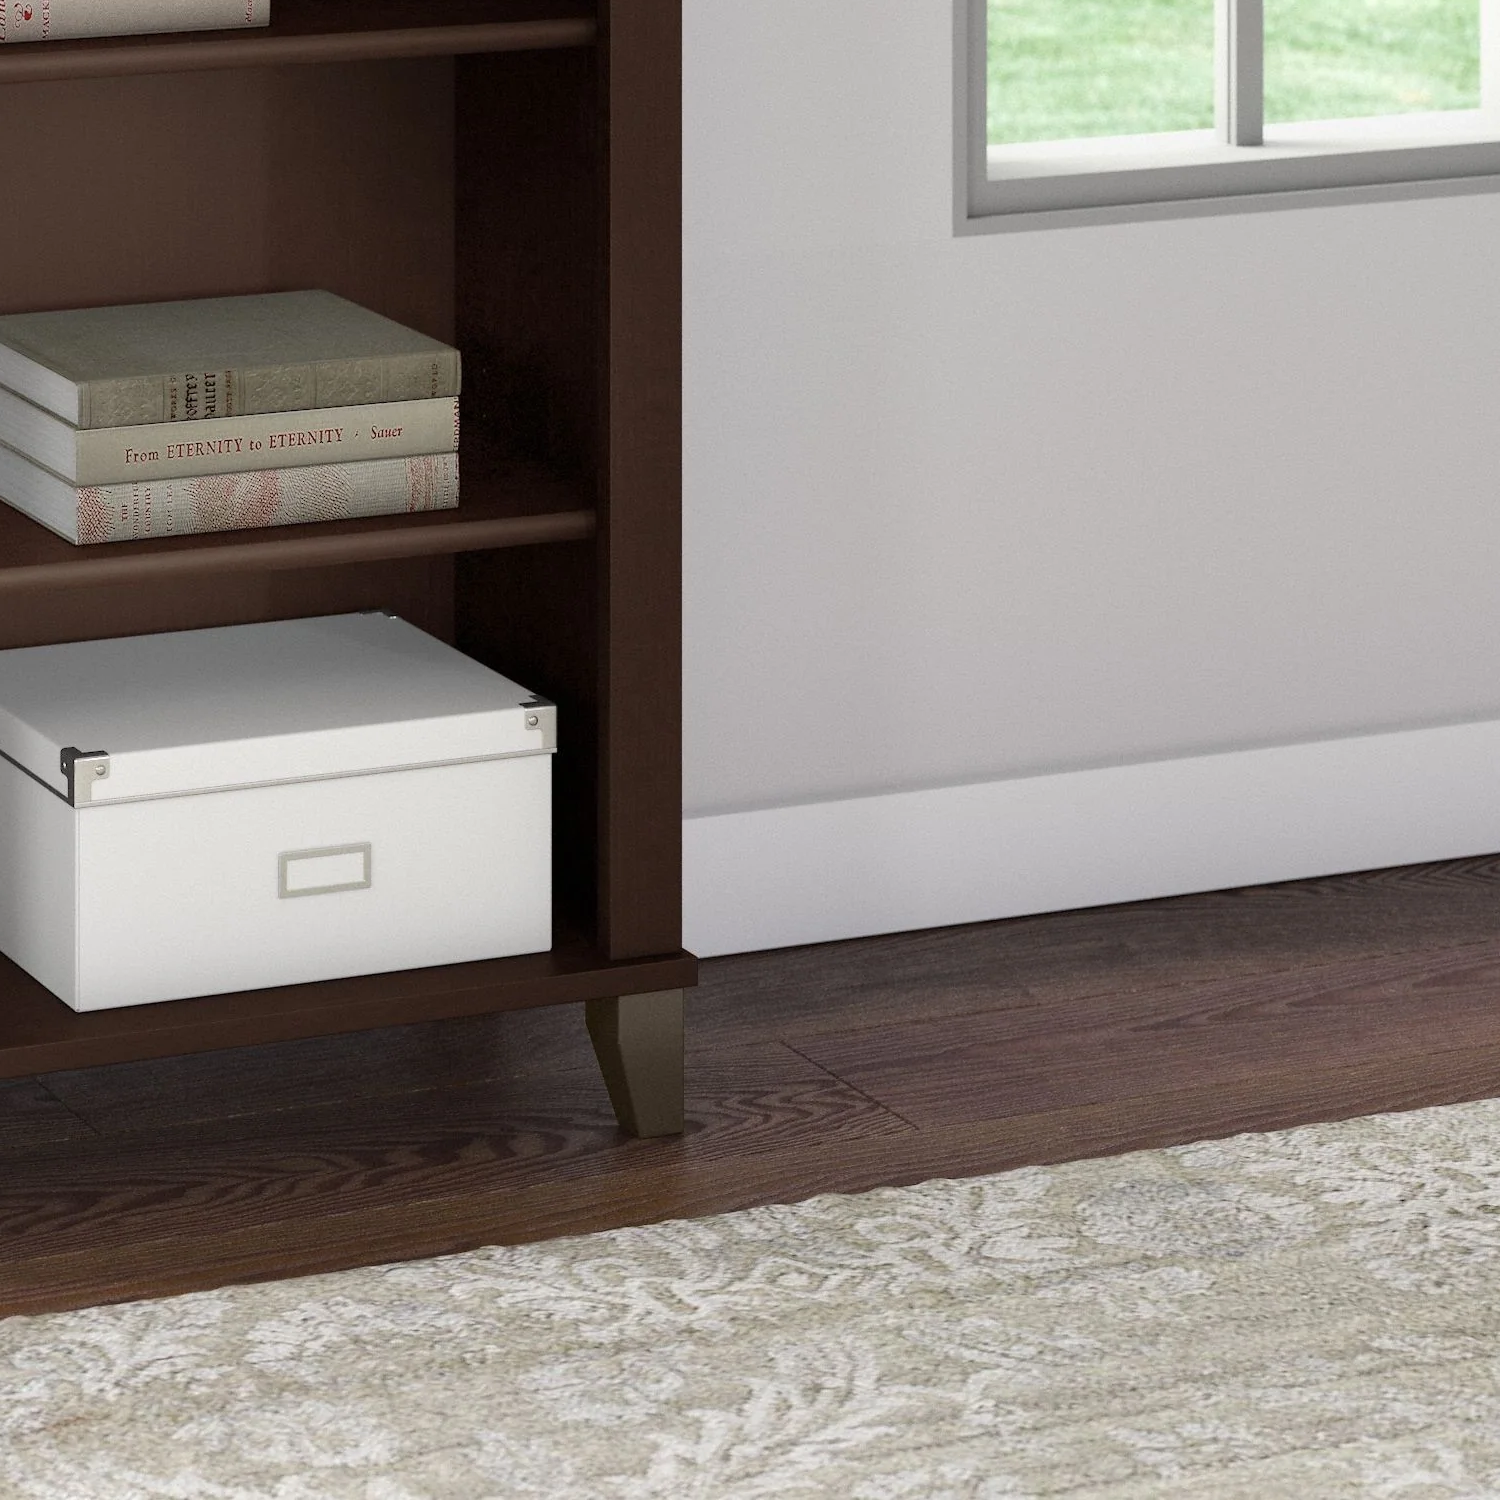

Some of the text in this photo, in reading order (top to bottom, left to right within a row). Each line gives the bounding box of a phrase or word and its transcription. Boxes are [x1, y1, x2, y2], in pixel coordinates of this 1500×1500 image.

[124, 424, 404, 464] From ETERNITY to ETERNITY Sauer
